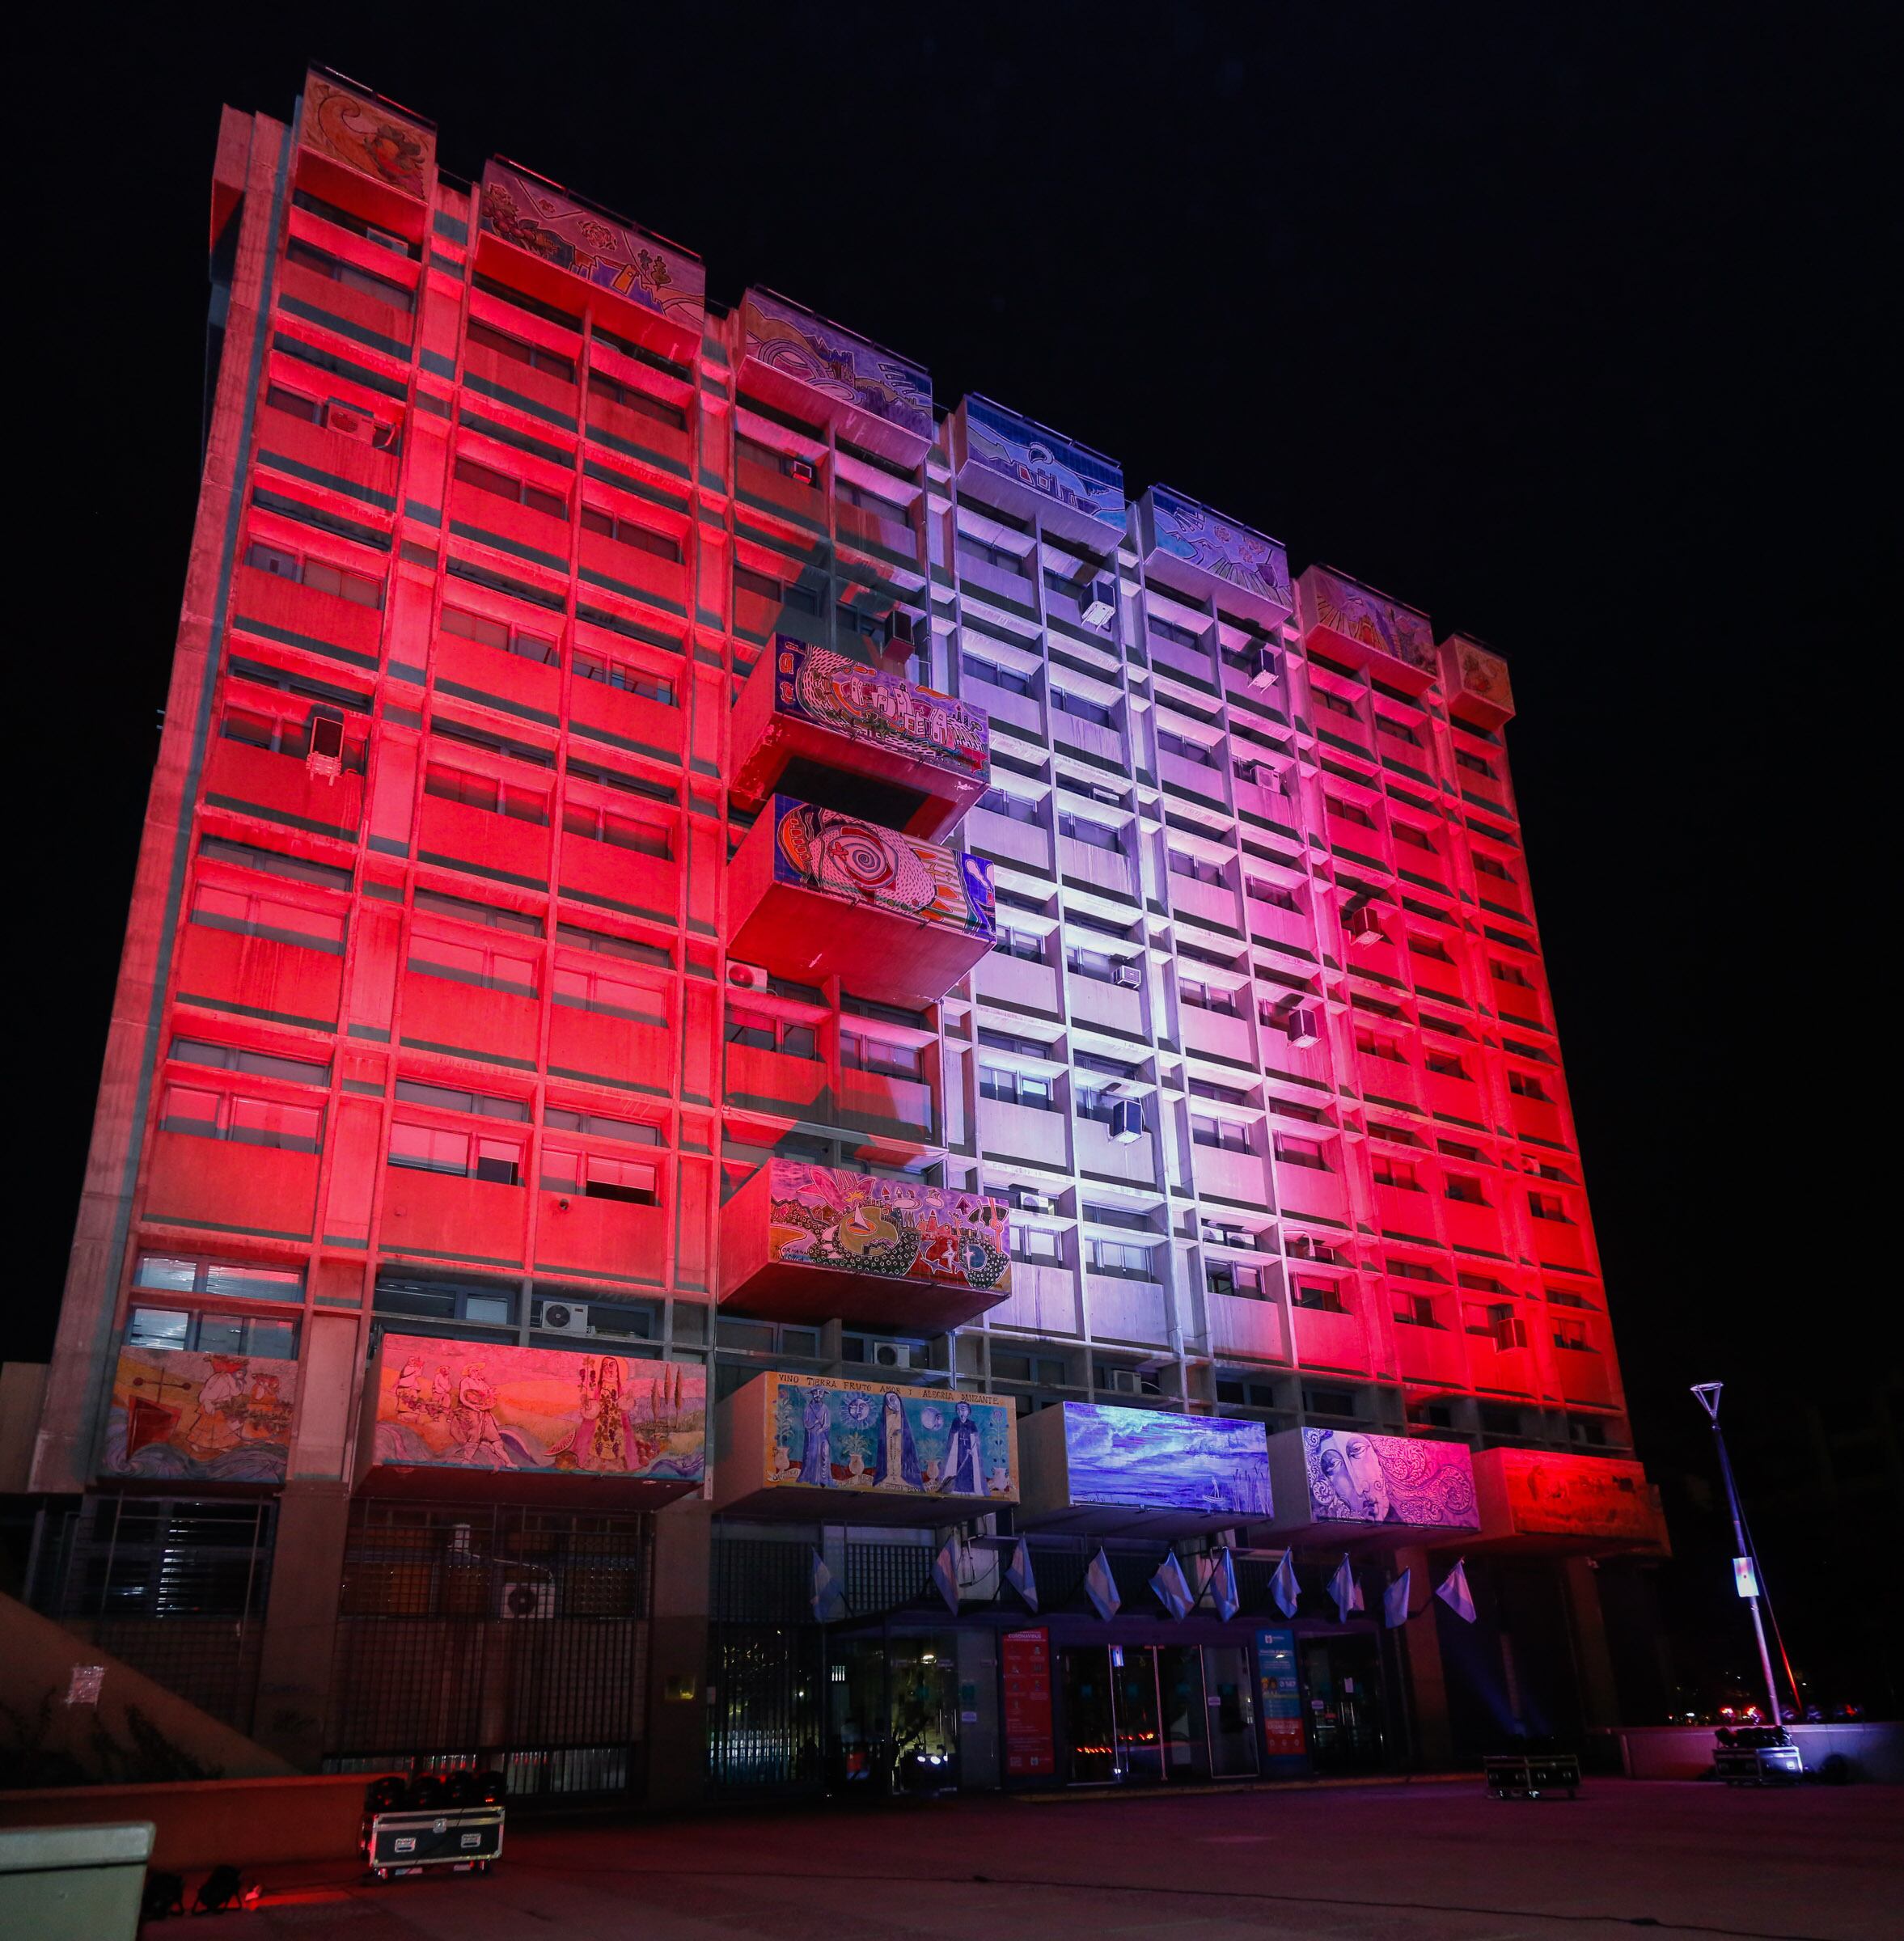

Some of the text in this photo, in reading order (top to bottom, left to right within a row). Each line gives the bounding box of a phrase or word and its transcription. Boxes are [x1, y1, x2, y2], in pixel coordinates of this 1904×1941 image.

[778, 1374, 799, 1384] VINO
[806, 1377, 836, 1388] TIERRA
[844, 1381, 871, 1392] FRUTO
[879, 1385, 901, 1394] AMOR
[922, 1389, 954, 1400] ALEGRIA
[961, 1393, 999, 1405] DANZANTE
